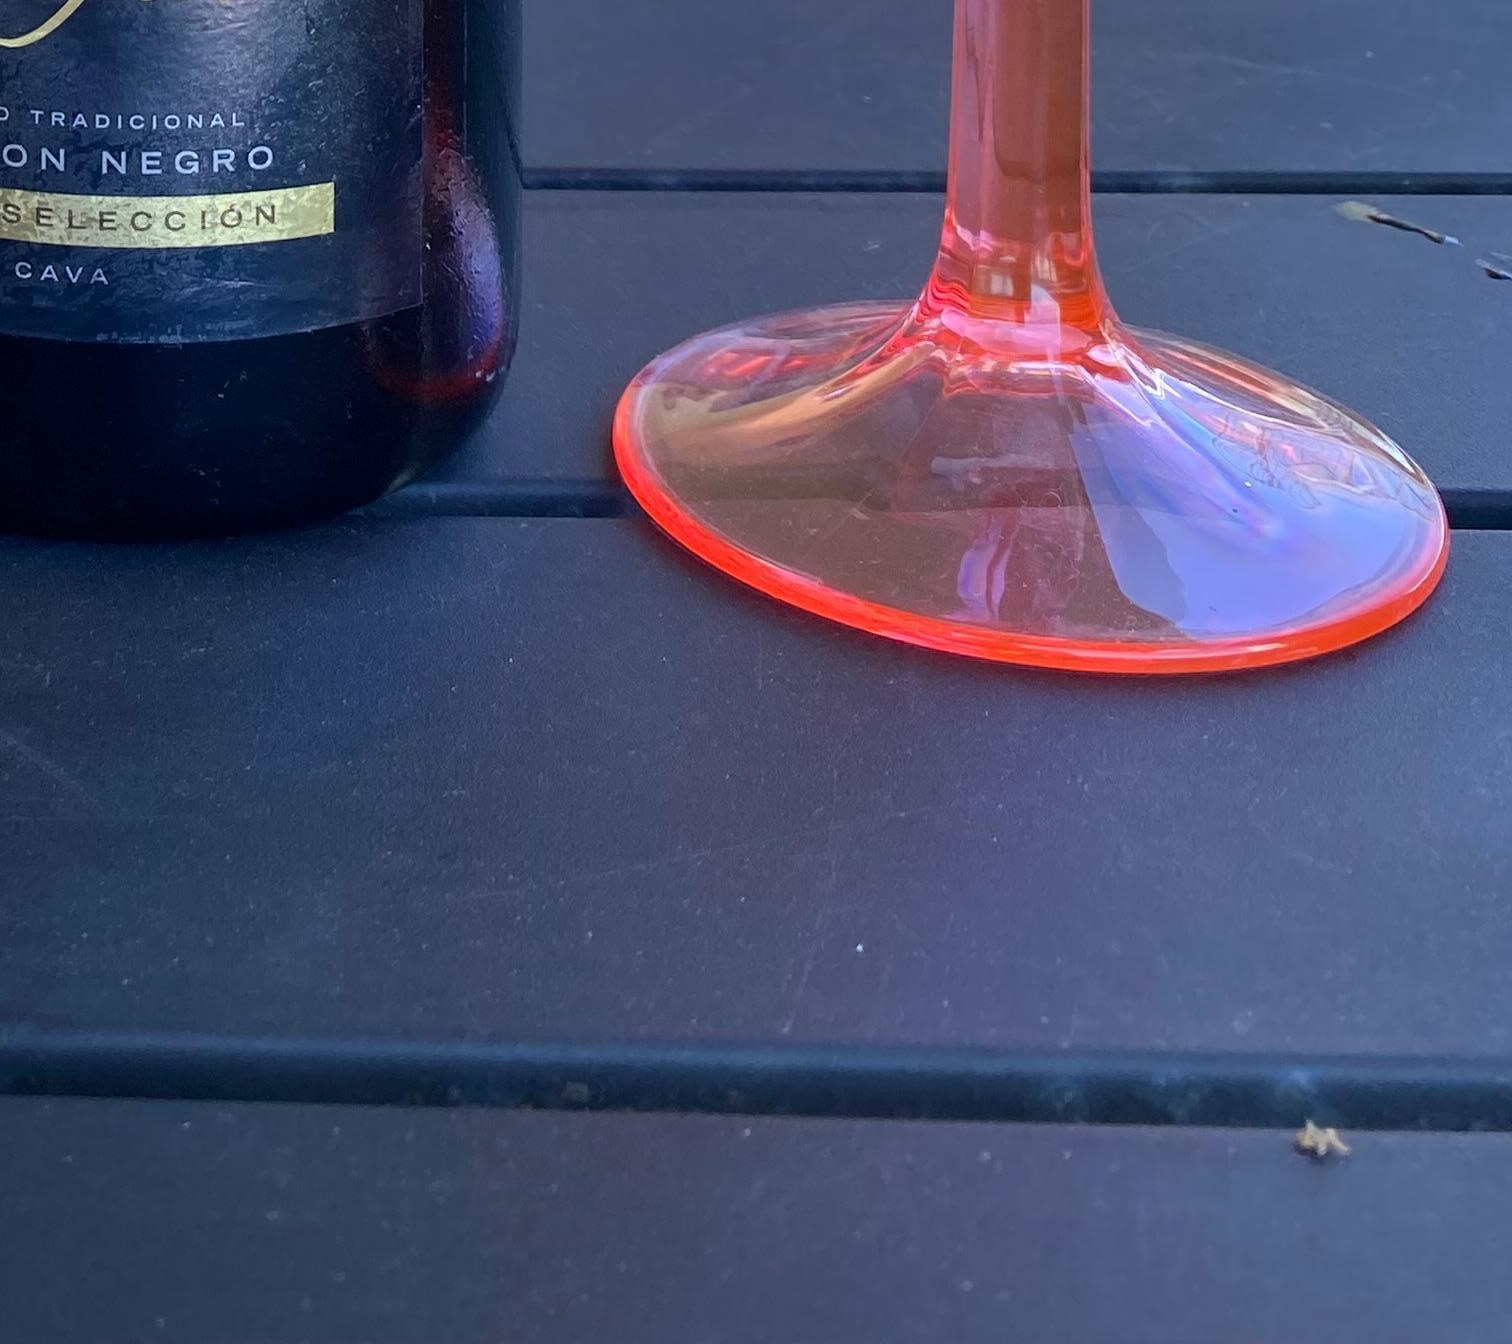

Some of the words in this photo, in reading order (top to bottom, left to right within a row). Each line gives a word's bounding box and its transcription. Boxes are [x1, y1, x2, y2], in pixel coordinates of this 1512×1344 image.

[30, 110, 245, 130] TRADICIONAL
[102, 146, 274, 175] NEGRO
[2, 202, 276, 231] SELECCIÓN
[14, 261, 109, 285] CAVA
